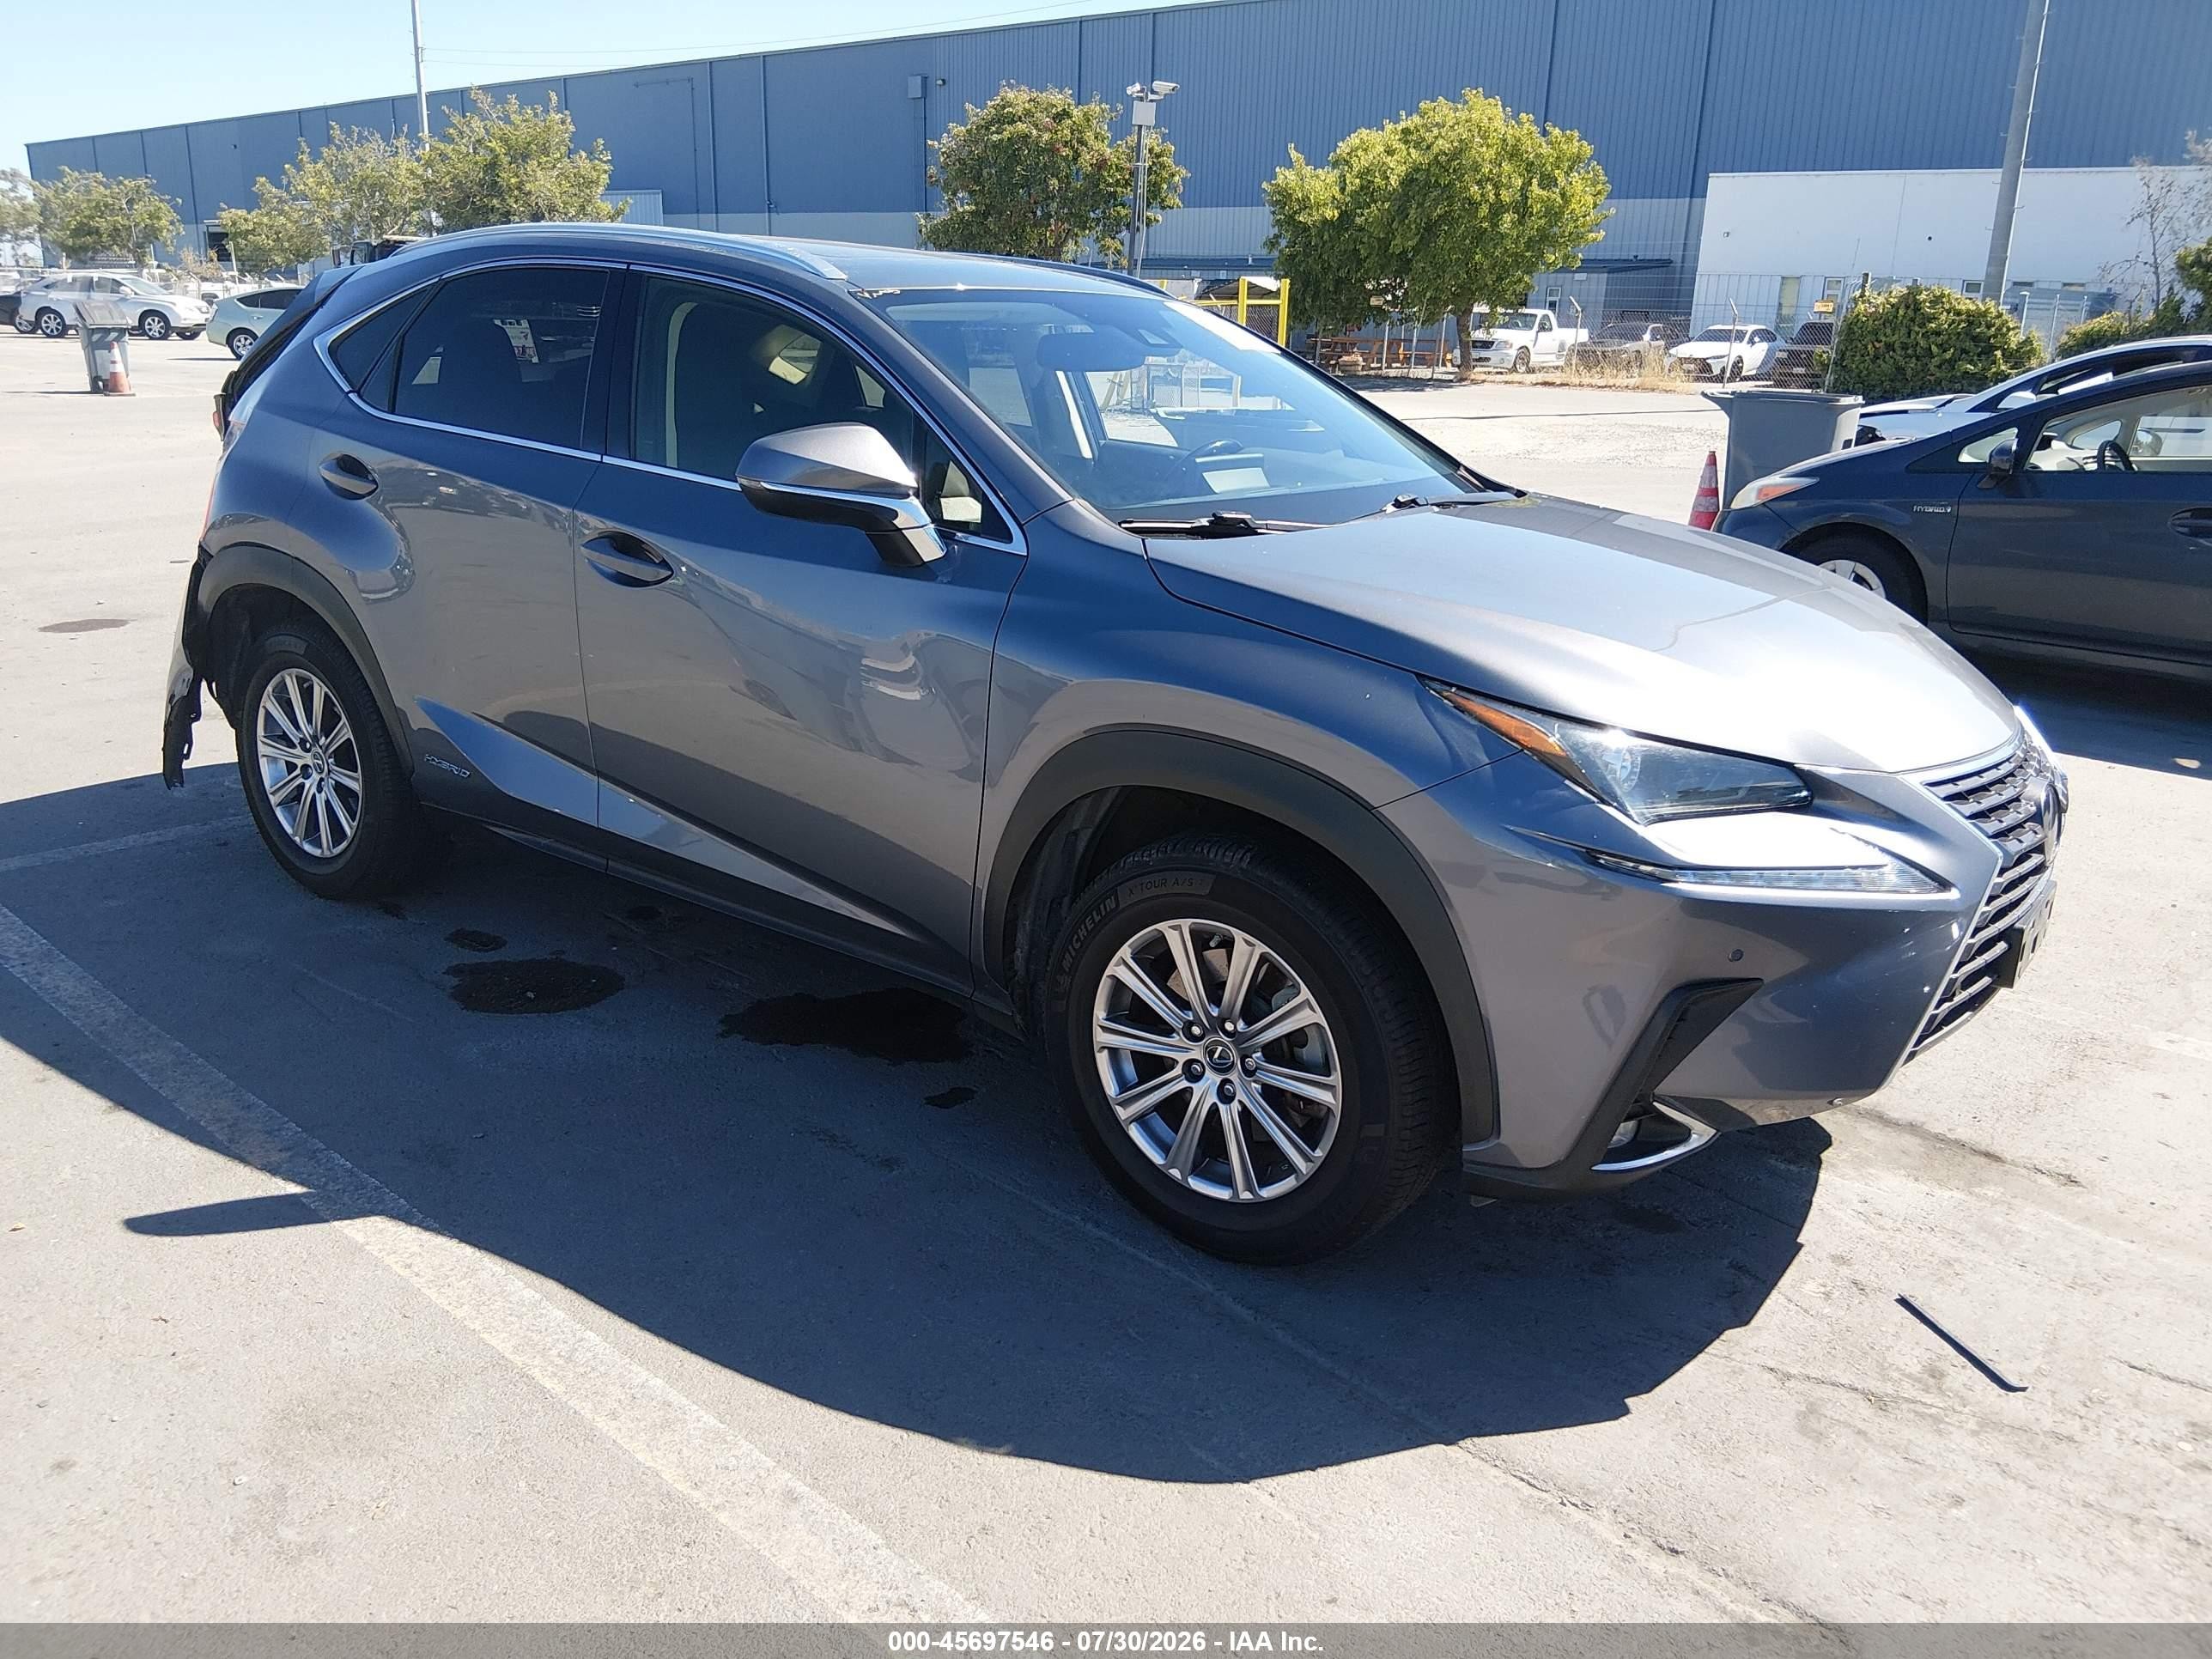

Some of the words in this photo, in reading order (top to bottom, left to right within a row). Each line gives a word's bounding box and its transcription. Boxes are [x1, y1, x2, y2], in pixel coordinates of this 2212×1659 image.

[424, 754, 471, 778] HYBRID
[1061, 894, 1117, 971] MICHELIN
[1139, 878, 1168, 892] TOUR
[1171, 877, 1194, 887] A/S
